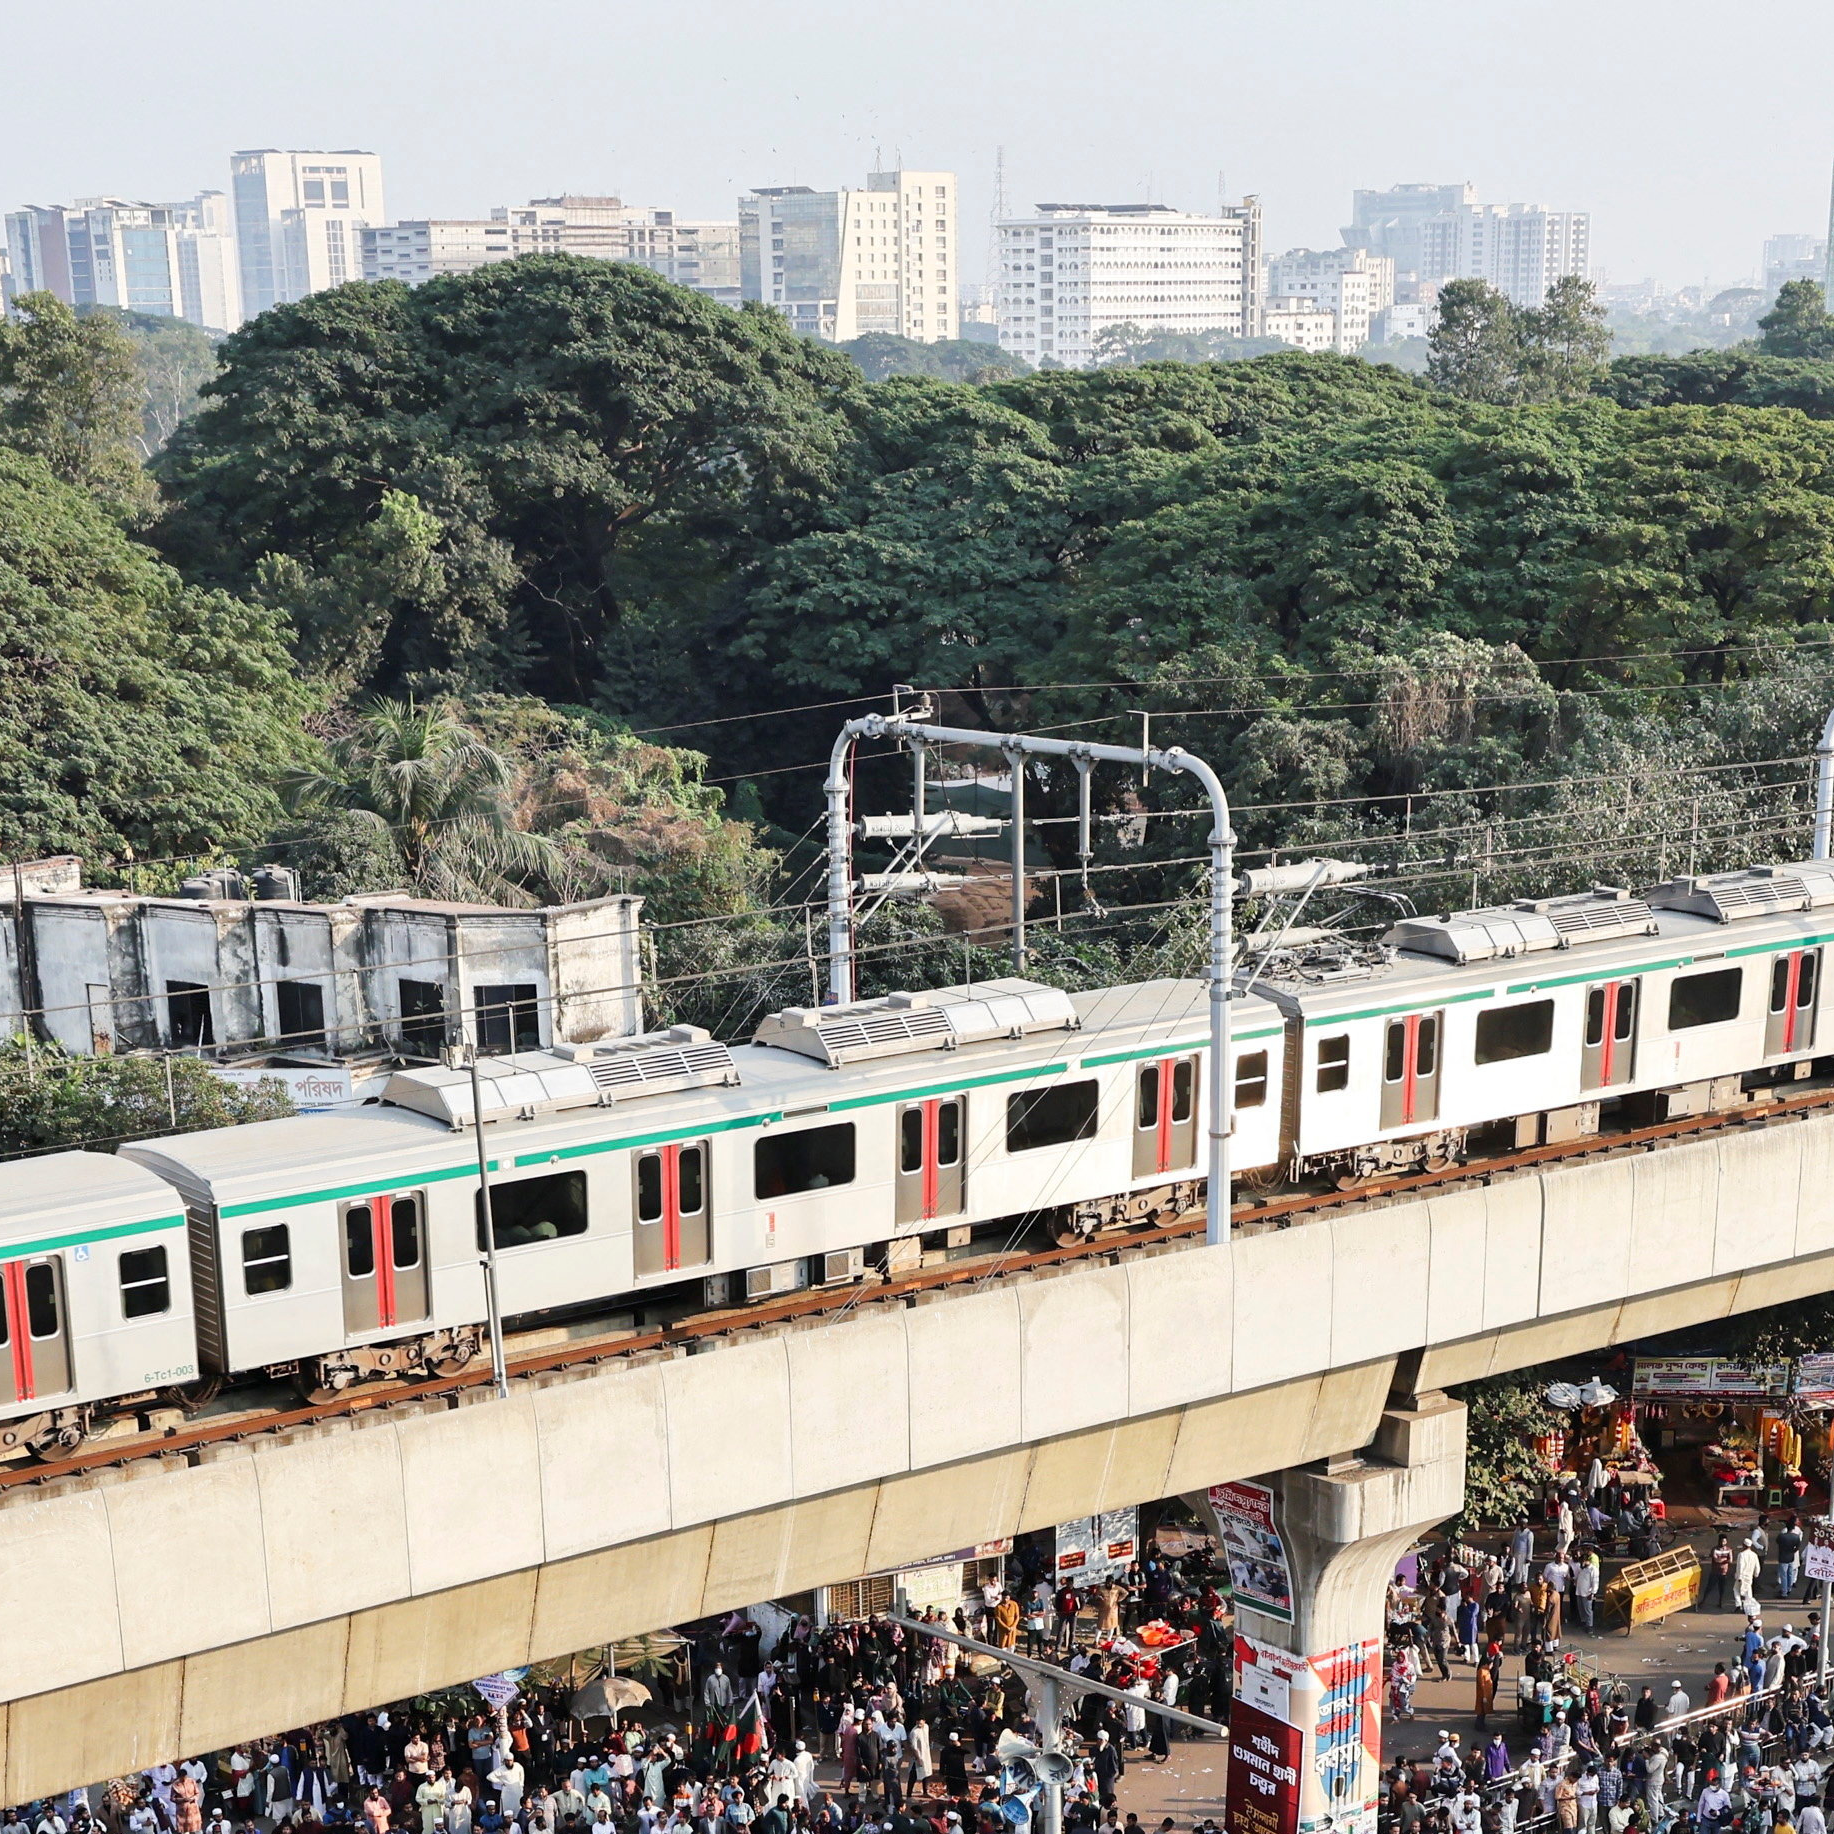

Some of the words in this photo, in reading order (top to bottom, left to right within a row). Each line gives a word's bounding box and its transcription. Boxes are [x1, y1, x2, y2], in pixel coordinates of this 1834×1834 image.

[295, 1075, 344, 1098] পরিষদ
[144, 1365, 195, 1383] 6-Tc1-003
[1251, 1734, 1280, 1759] শহীদ
[1233, 1744, 1271, 1773] ওসমান
[1272, 1765, 1297, 1787] হাদী
[1244, 1798, 1279, 1831] ইসলামী
